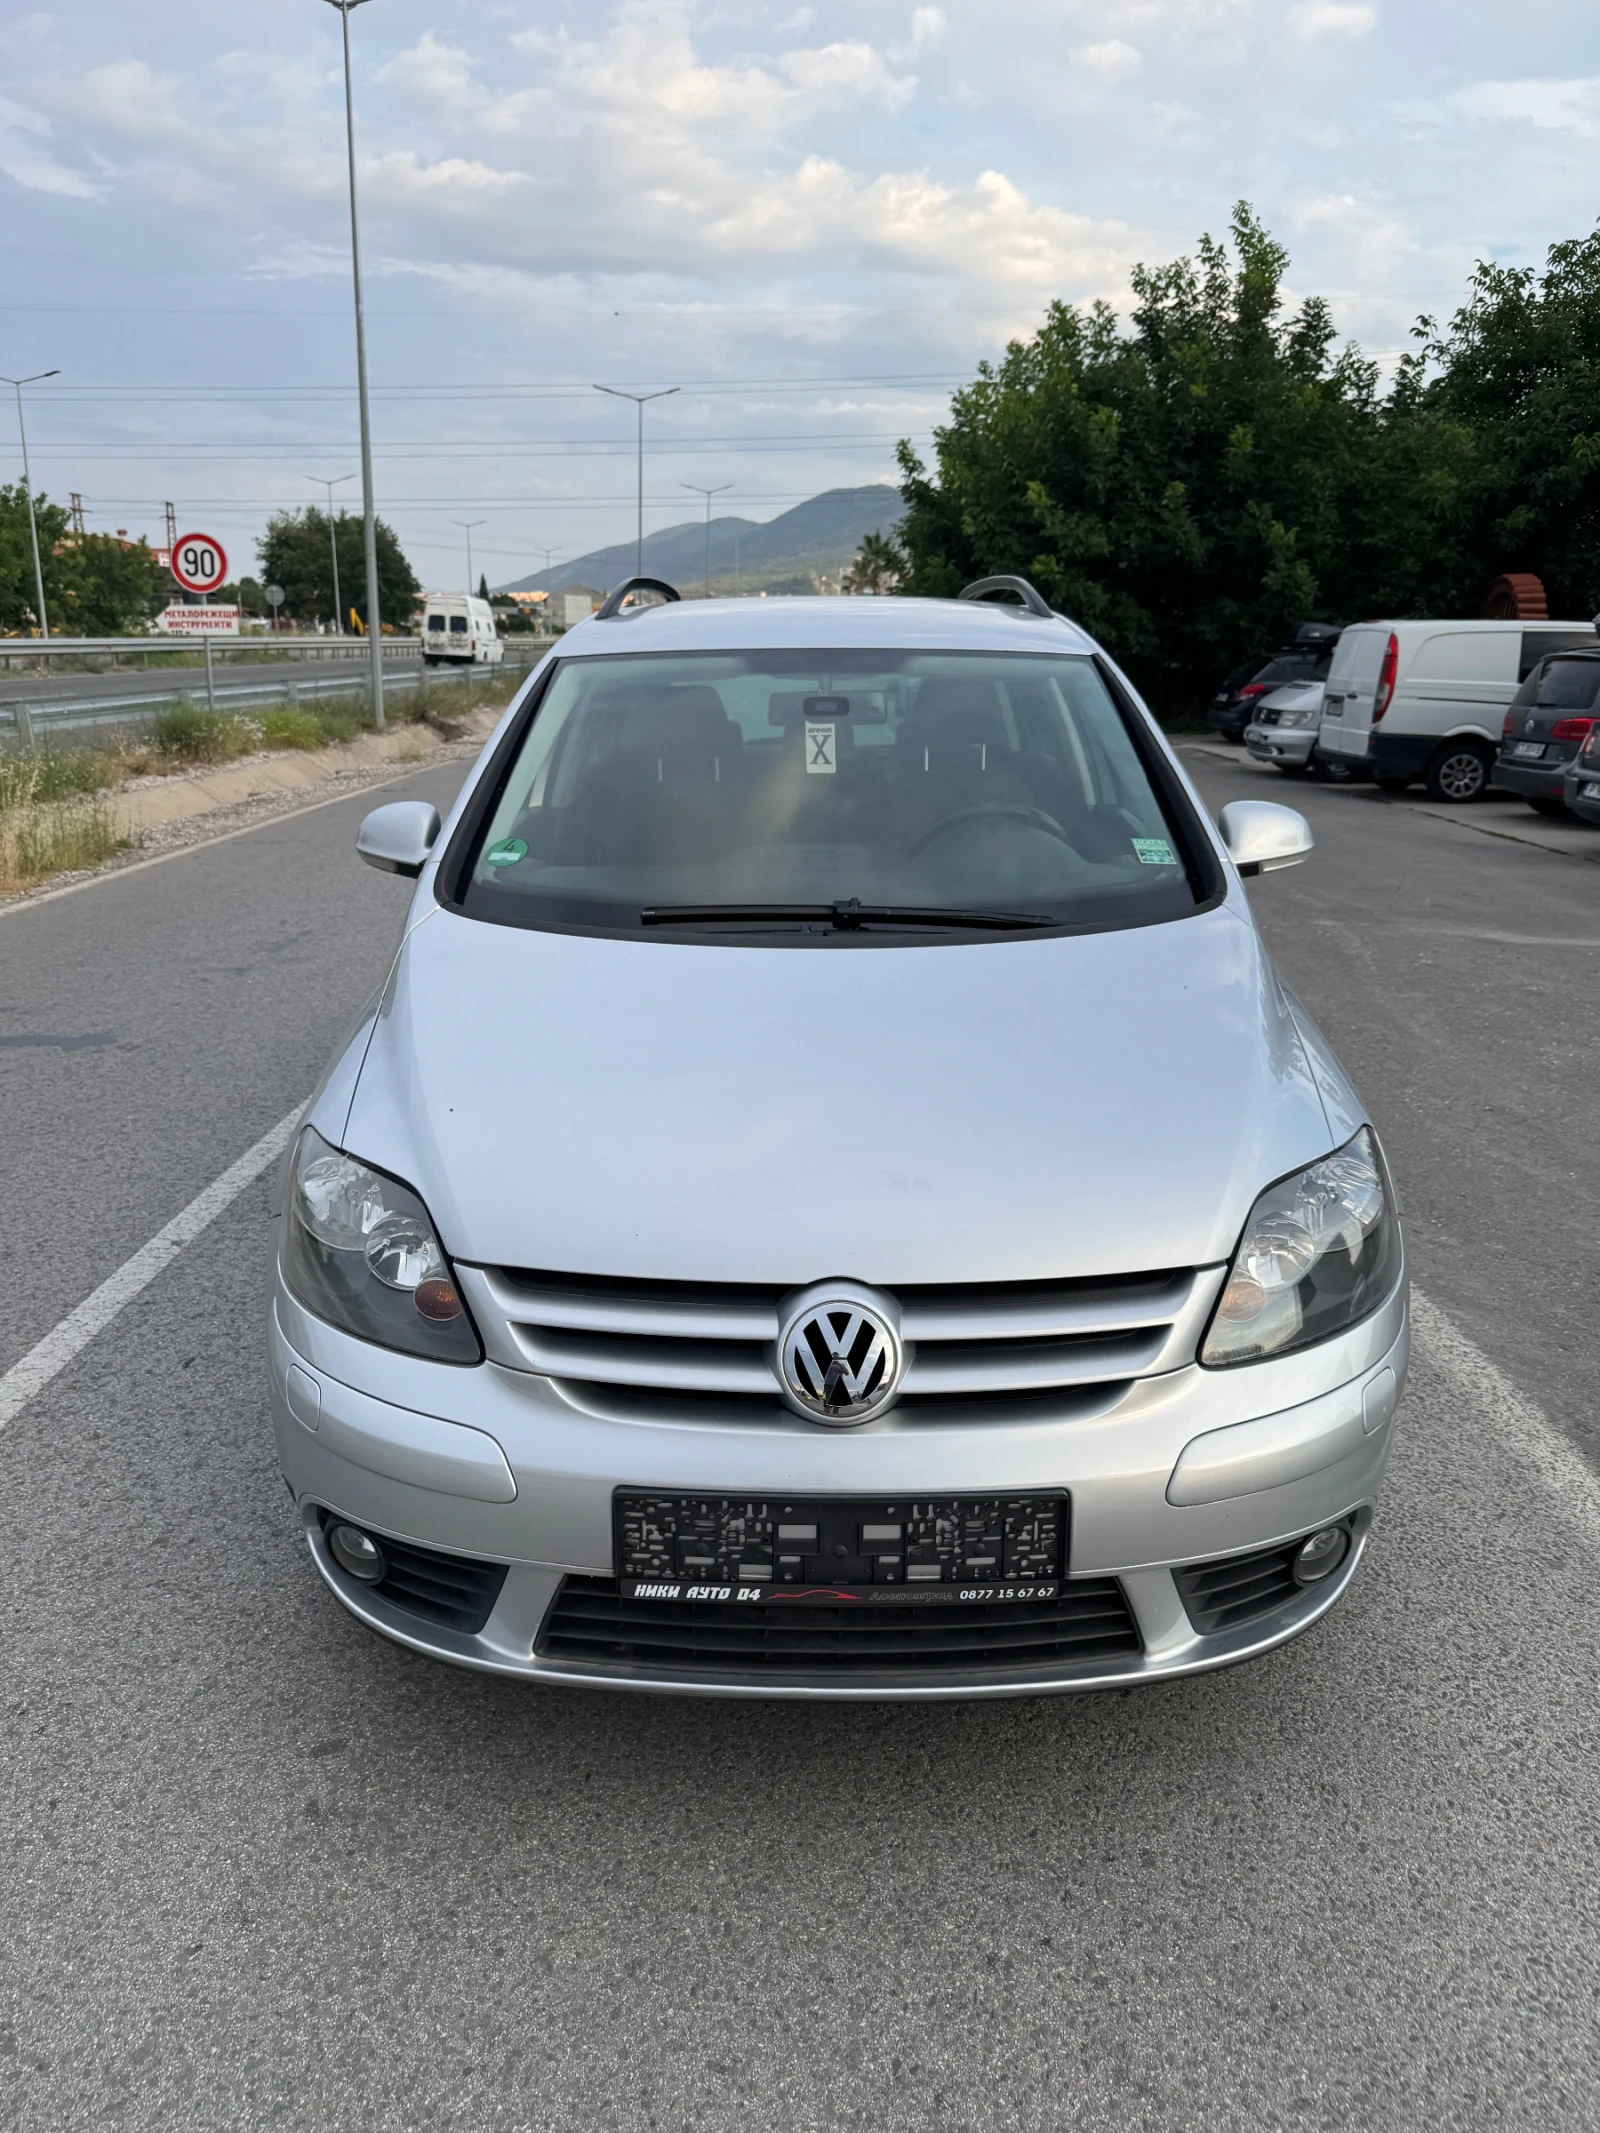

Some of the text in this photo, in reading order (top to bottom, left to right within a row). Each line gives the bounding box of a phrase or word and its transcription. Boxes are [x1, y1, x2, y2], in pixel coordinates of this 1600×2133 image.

[184, 548, 214, 577] 90
[164, 610, 238, 618] МЕТАЛОРЕЖЕЩИ
[168, 621, 232, 629] ИНСТРУМЕНТИ
[808, 734, 832, 765] X
[503, 839, 516, 852] 4
[634, 1584, 681, 1597] НИКИ
[686, 1586, 732, 1600] АУТО
[959, 1587, 1054, 1600] 0877 15 67 67
